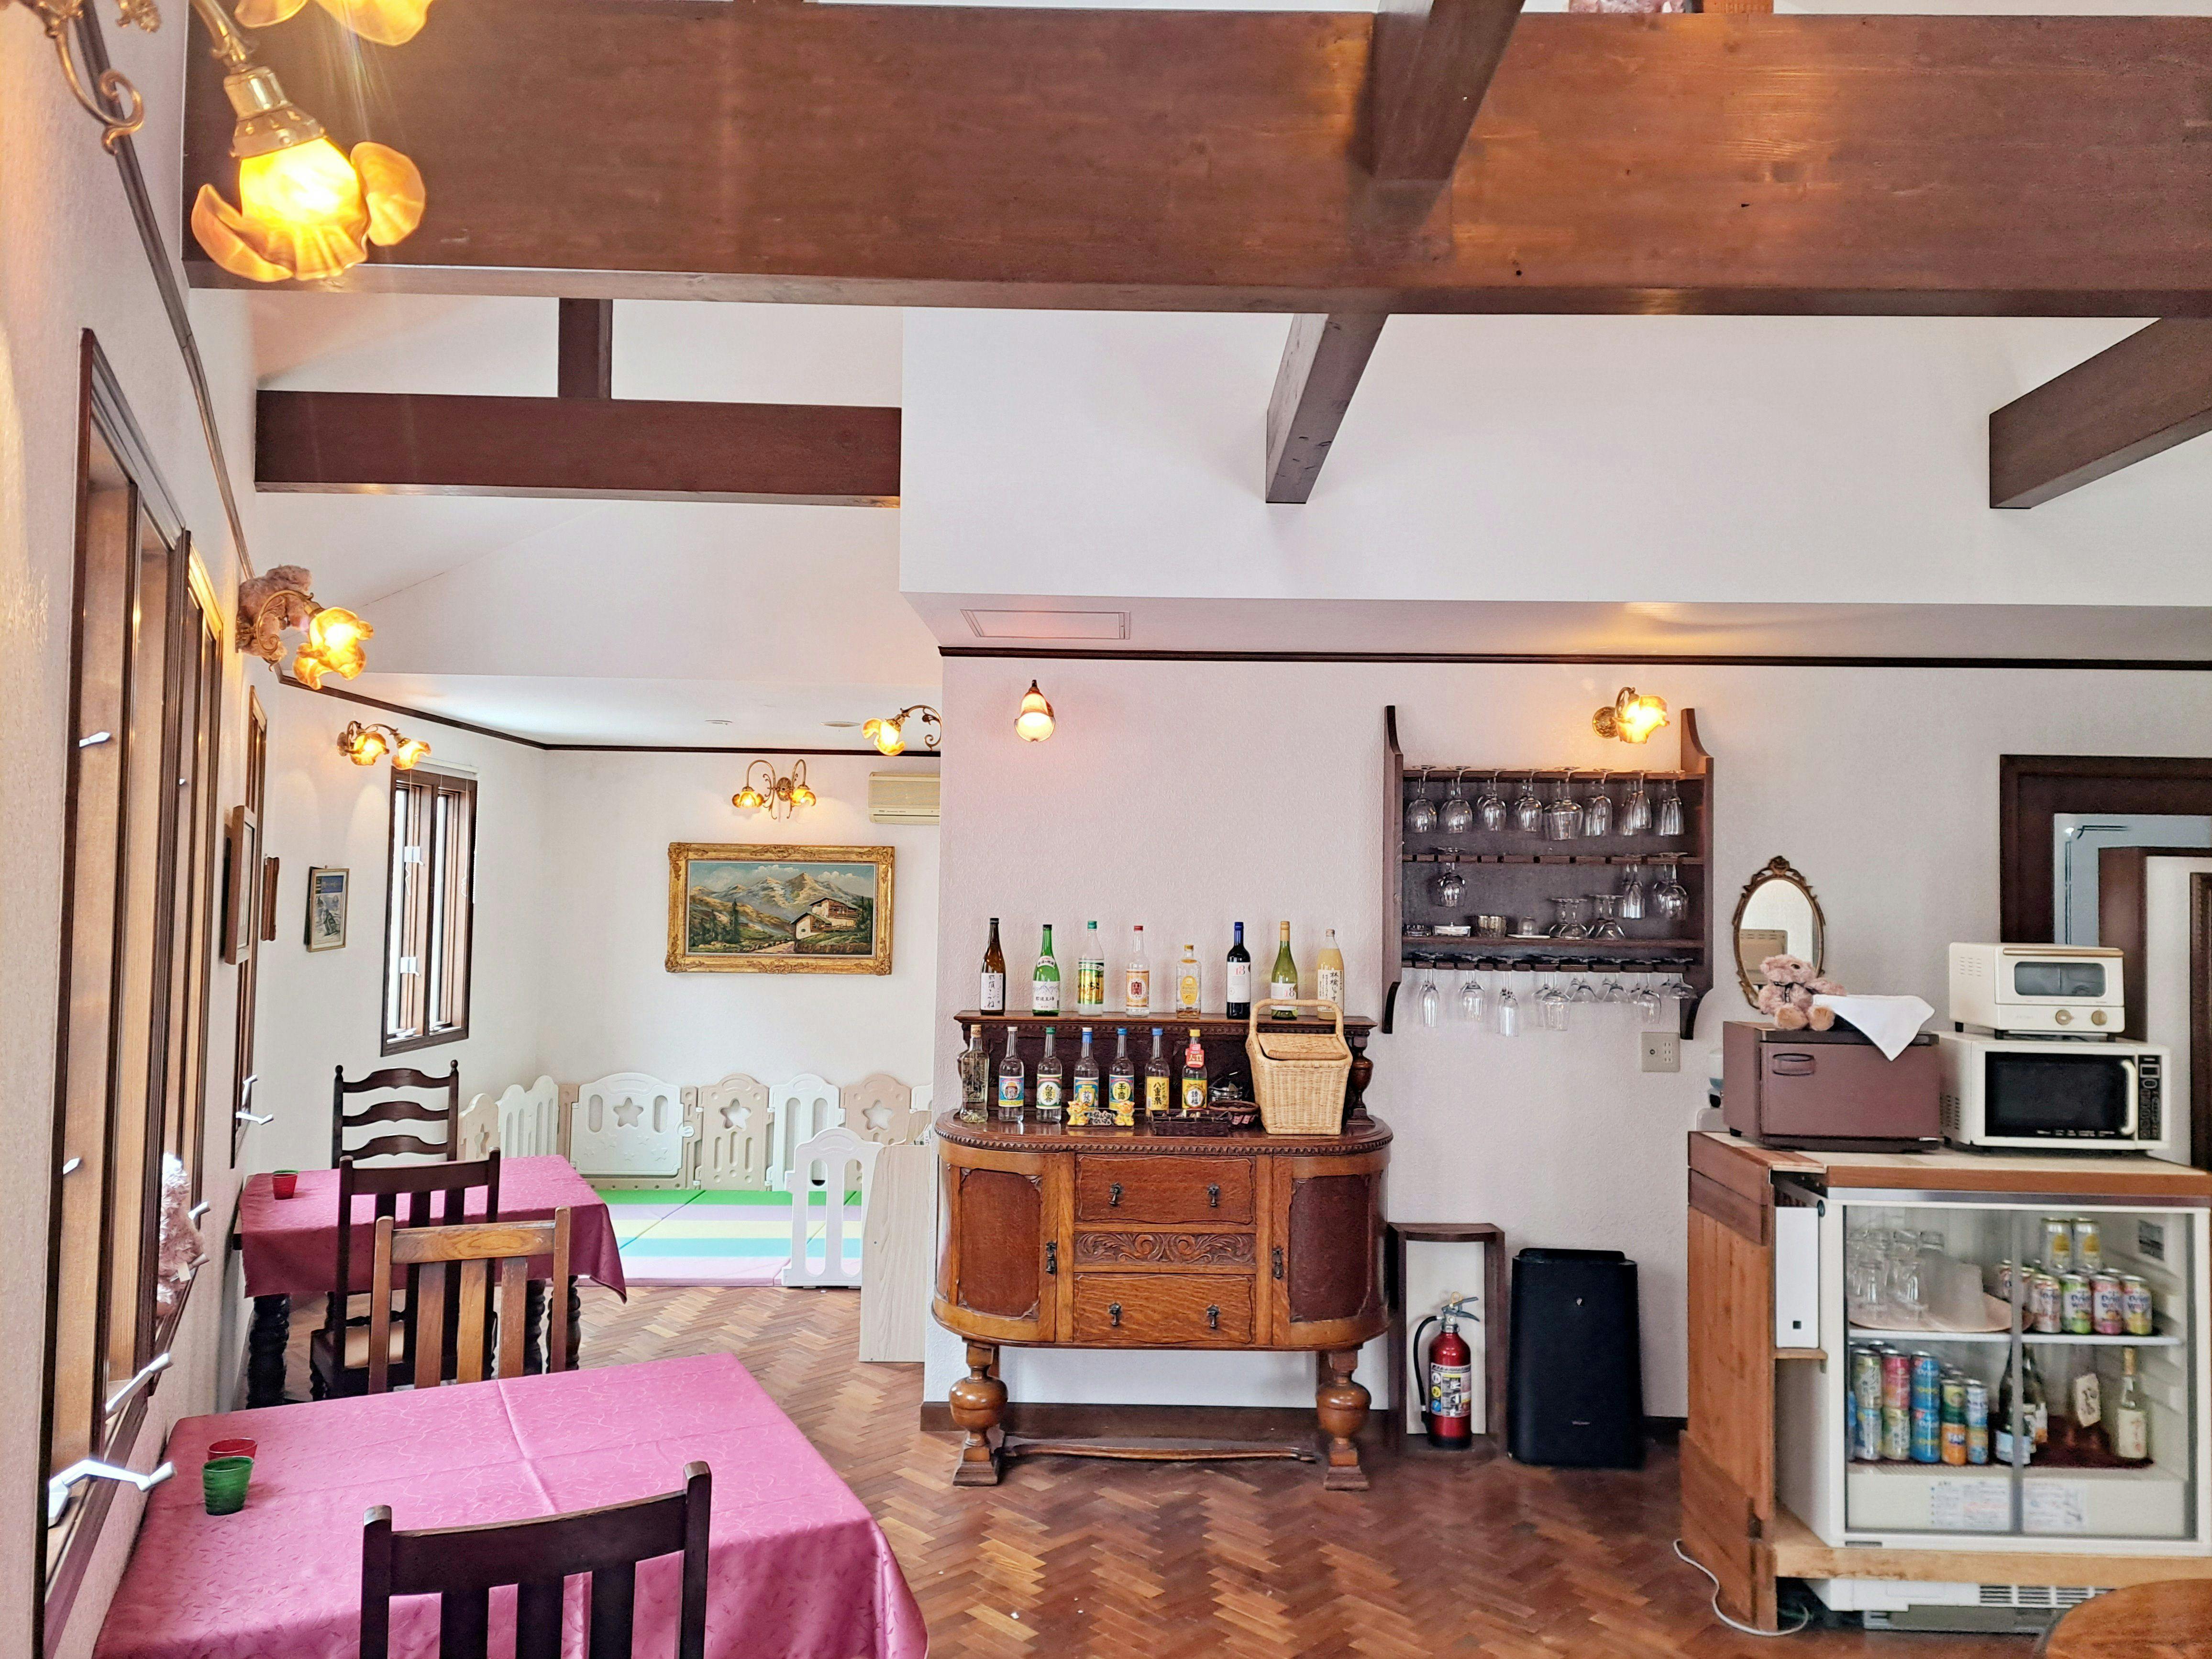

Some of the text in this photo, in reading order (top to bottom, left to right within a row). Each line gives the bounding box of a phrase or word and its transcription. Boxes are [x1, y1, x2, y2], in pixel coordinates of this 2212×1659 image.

[1236, 965, 1245, 975] 18
[1284, 987, 1294, 997] 18
[1044, 1084, 1053, 1103] 白百合
[1153, 1082, 1161, 1105] 八重泉
